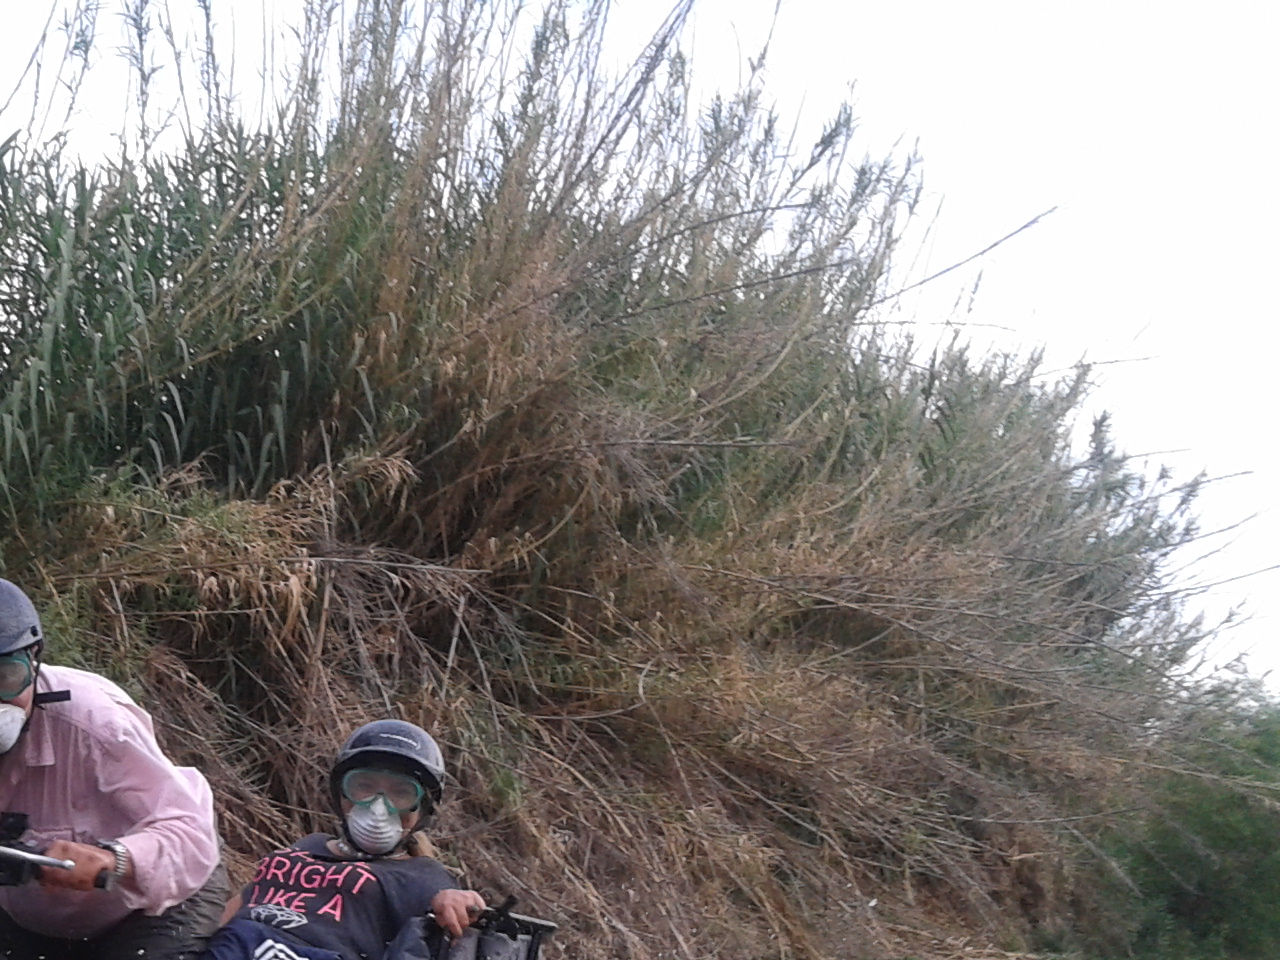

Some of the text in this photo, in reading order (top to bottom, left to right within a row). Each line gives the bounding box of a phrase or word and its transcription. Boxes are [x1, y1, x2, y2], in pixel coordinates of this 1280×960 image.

[253, 856, 376, 895] BRIGHT
[248, 885, 343, 922] LIKE A
